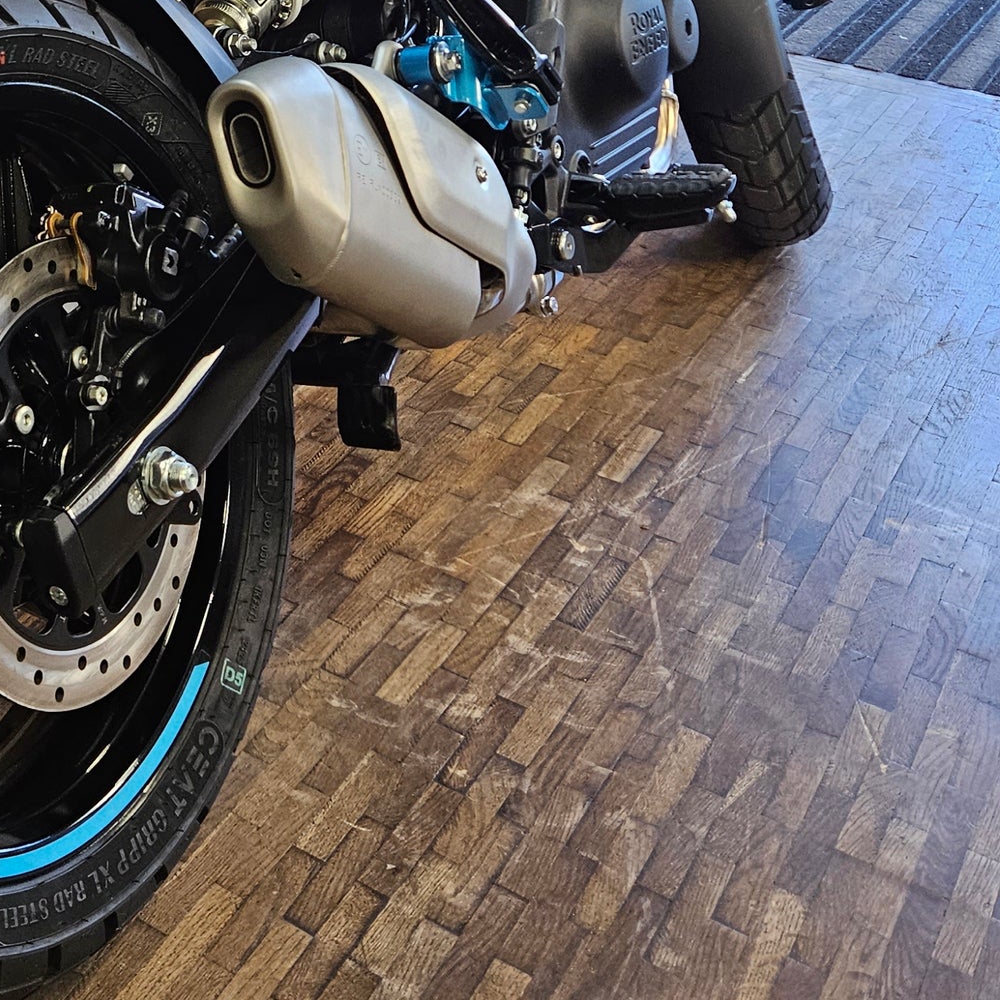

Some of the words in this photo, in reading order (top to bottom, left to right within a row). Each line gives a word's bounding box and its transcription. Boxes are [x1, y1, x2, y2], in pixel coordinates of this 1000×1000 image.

[628, 4, 664, 36] ROYAL
[22, 46, 56, 65] RAD
[56, 50, 101, 78] STEEL
[224, 665, 244, 688] D5
[165, 726, 219, 817] CEAT
[116, 808, 168, 876] GRIPP
[87, 860, 116, 895] XL
[53, 879, 88, 913] RAD
